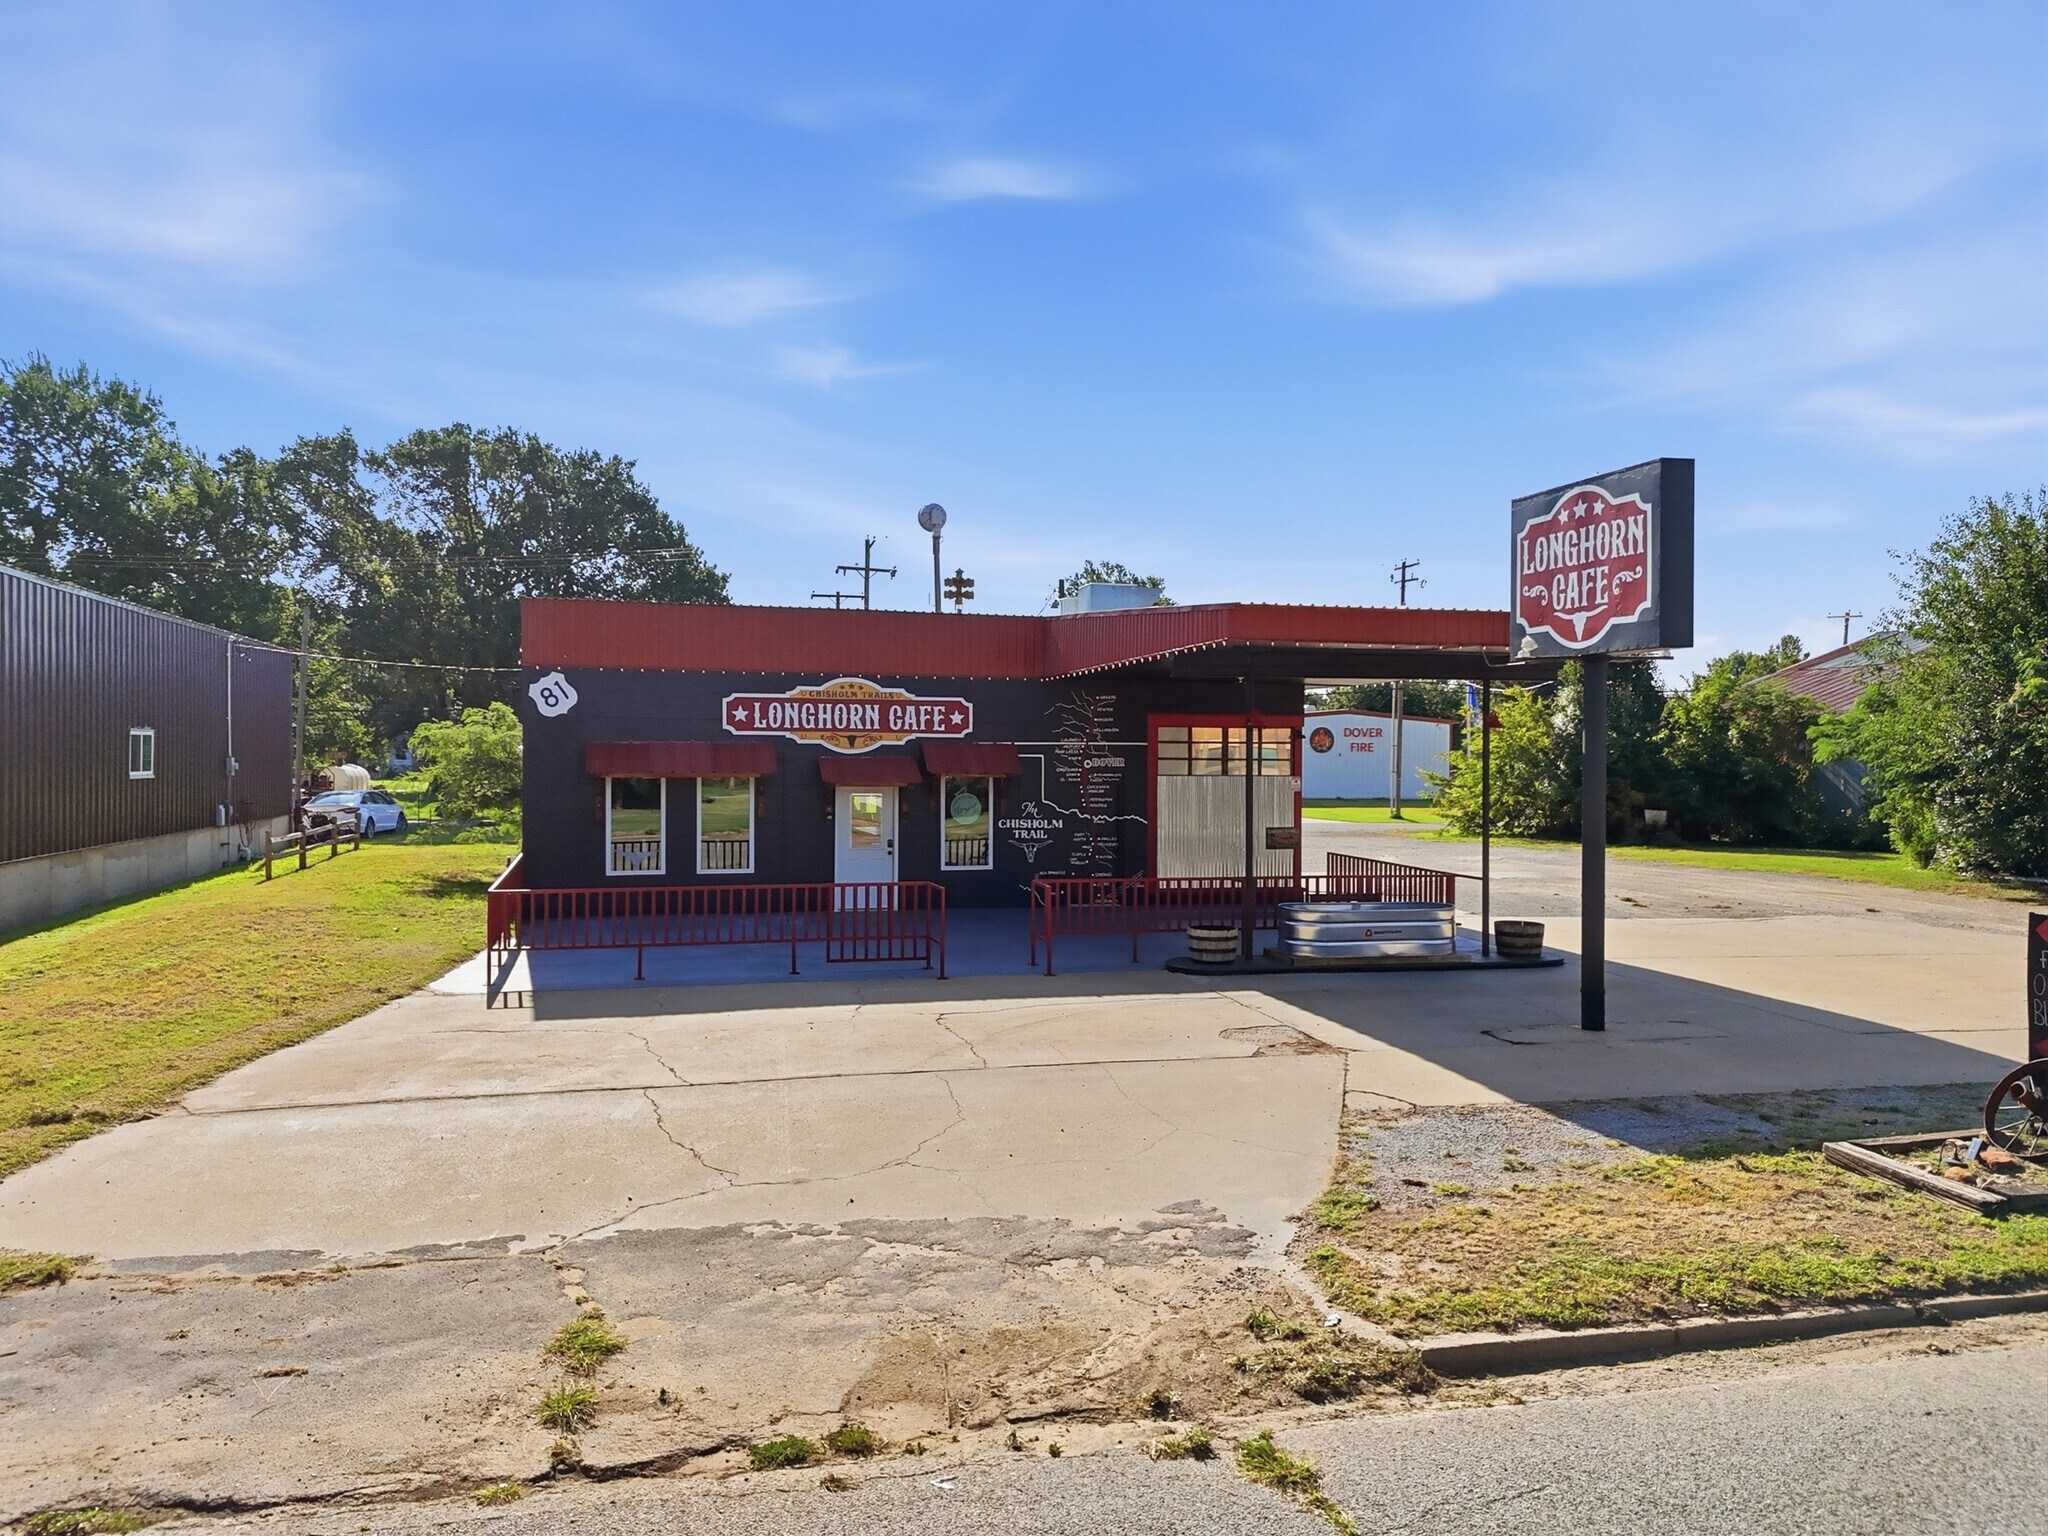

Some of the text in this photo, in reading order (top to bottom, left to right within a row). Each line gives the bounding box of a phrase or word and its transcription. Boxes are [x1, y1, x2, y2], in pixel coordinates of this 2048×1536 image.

[1522, 514, 1645, 576] LONGHORN
[1551, 565, 1610, 610] CAFE
[540, 680, 569, 708] 81
[808, 690, 895, 700] CHISHOLM TRAILS
[753, 701, 946, 731] LONGHORN CAFE
[1343, 727, 1383, 738] DOVER
[1350, 742, 1375, 752] FIRE
[1091, 757, 1126, 767] DOVER
[1021, 801, 1043, 818] The
[998, 818, 1063, 829] CHISHOLM
[1013, 829, 1048, 839] TRAIL
